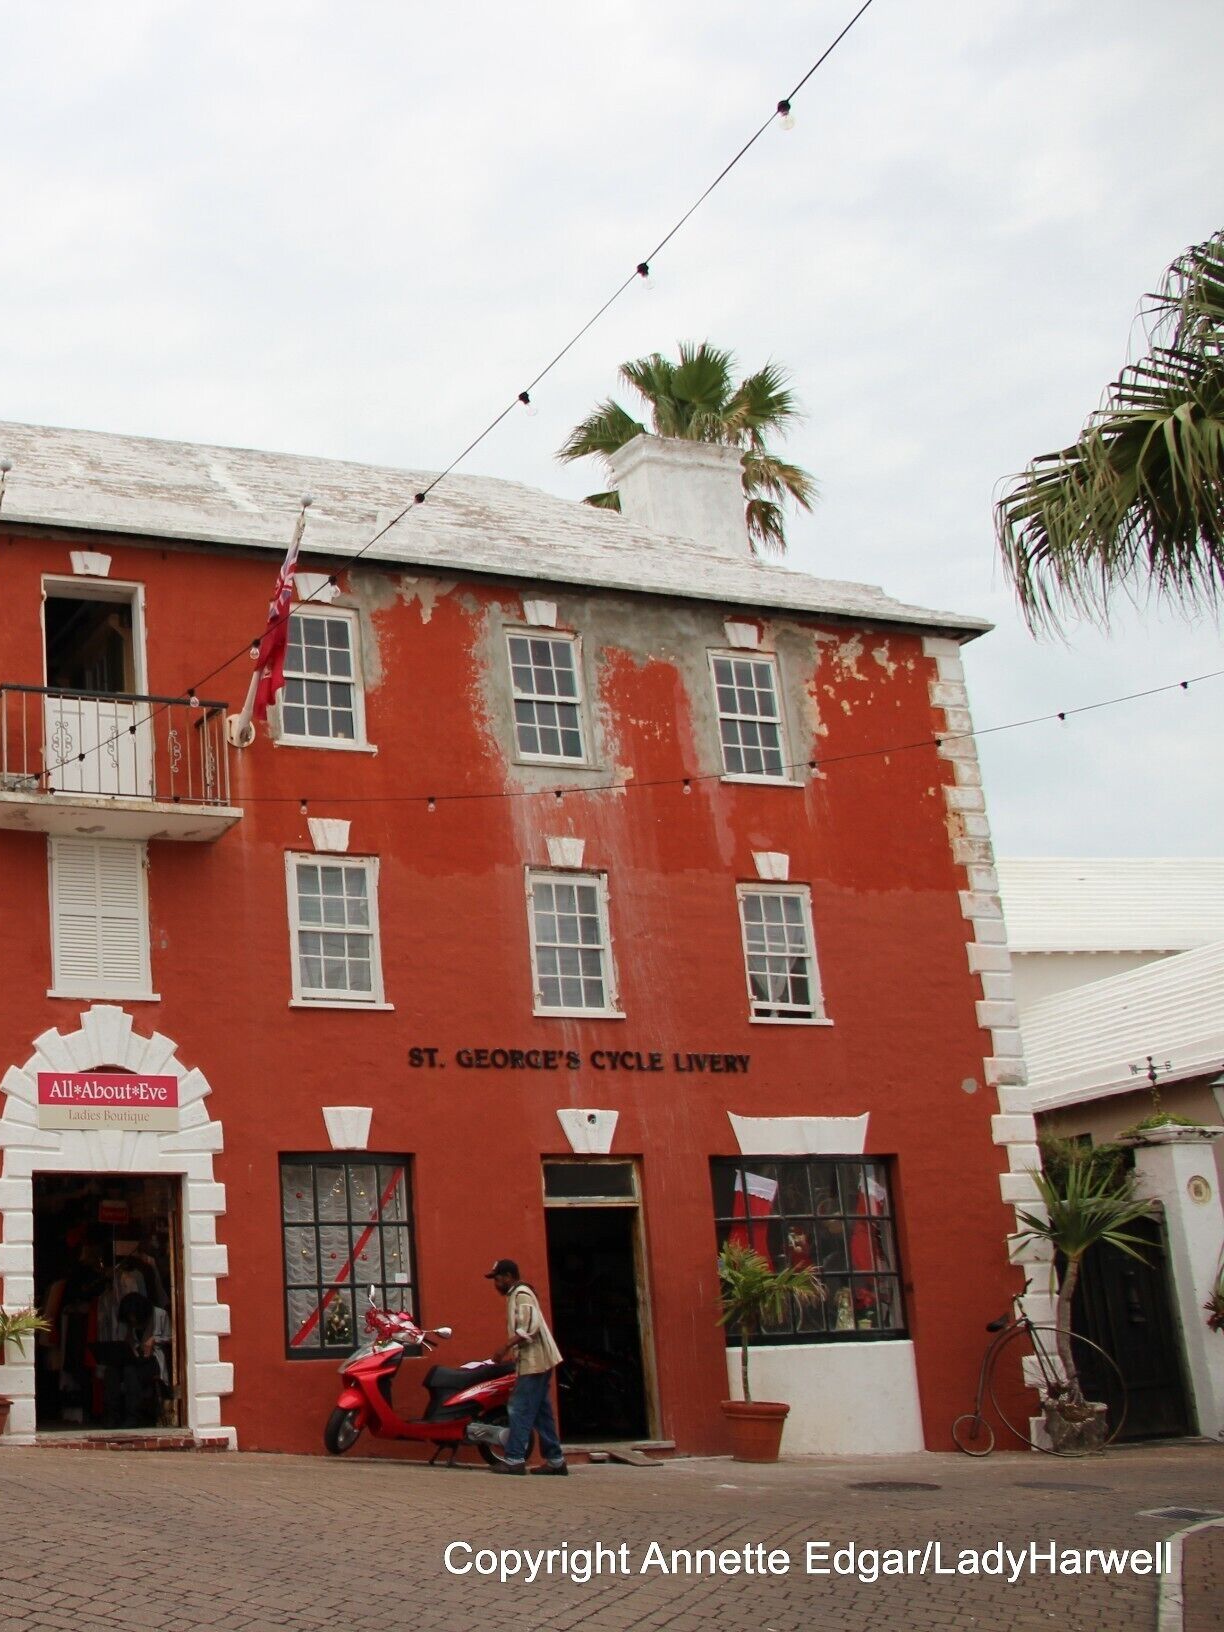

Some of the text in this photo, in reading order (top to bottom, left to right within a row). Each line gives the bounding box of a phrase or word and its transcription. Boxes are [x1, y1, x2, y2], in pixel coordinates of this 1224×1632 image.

[408, 1047, 751, 1074] ST. GEORGE'S CYCLE LIVERY
[68, 1109, 150, 1124] Ladies Boutique
